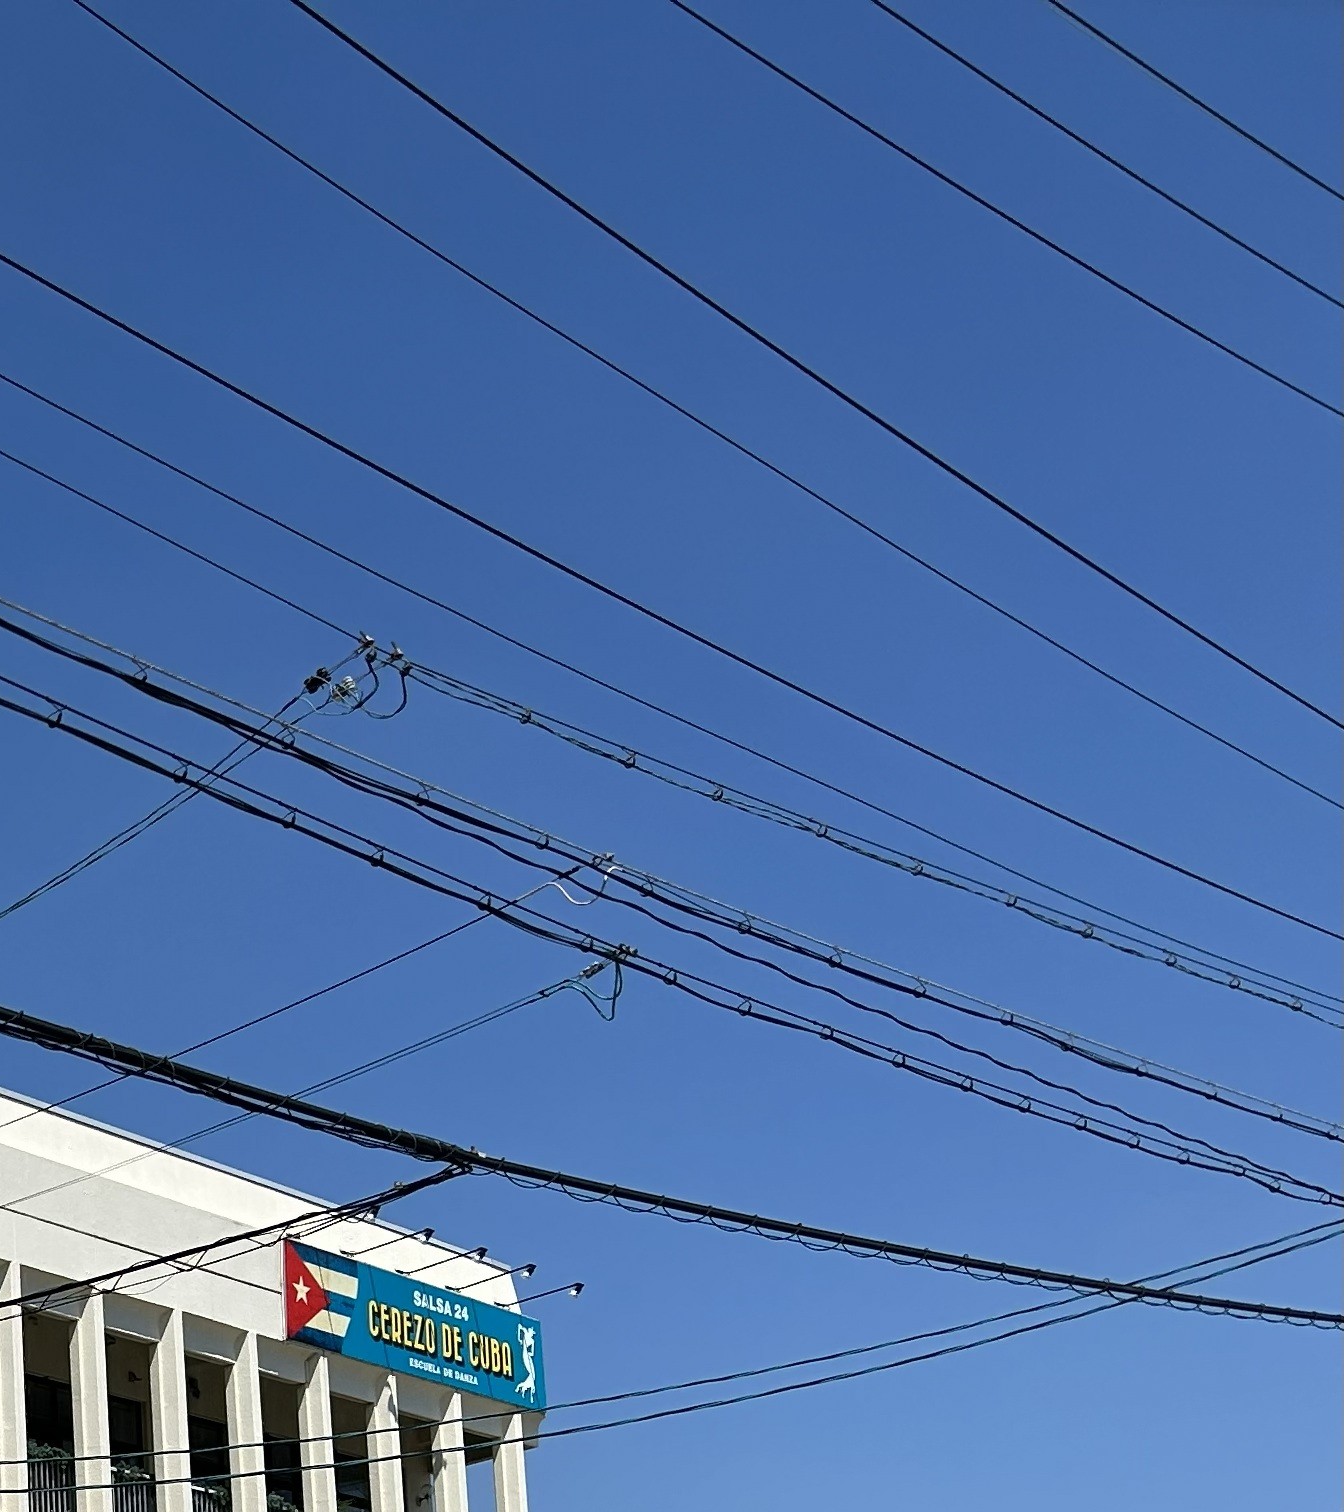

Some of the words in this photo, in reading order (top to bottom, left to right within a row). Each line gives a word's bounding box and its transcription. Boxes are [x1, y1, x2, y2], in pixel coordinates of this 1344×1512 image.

[413, 1290, 452, 1317] SALSA
[453, 1303, 470, 1322] 24
[368, 1299, 436, 1355] CEREZO
[441, 1321, 463, 1363] DE
[468, 1330, 514, 1378] CUBA
[409, 1357, 441, 1376] ESCUELA
[443, 1367, 454, 1380] DE
[454, 1369, 479, 1386] DANZA
